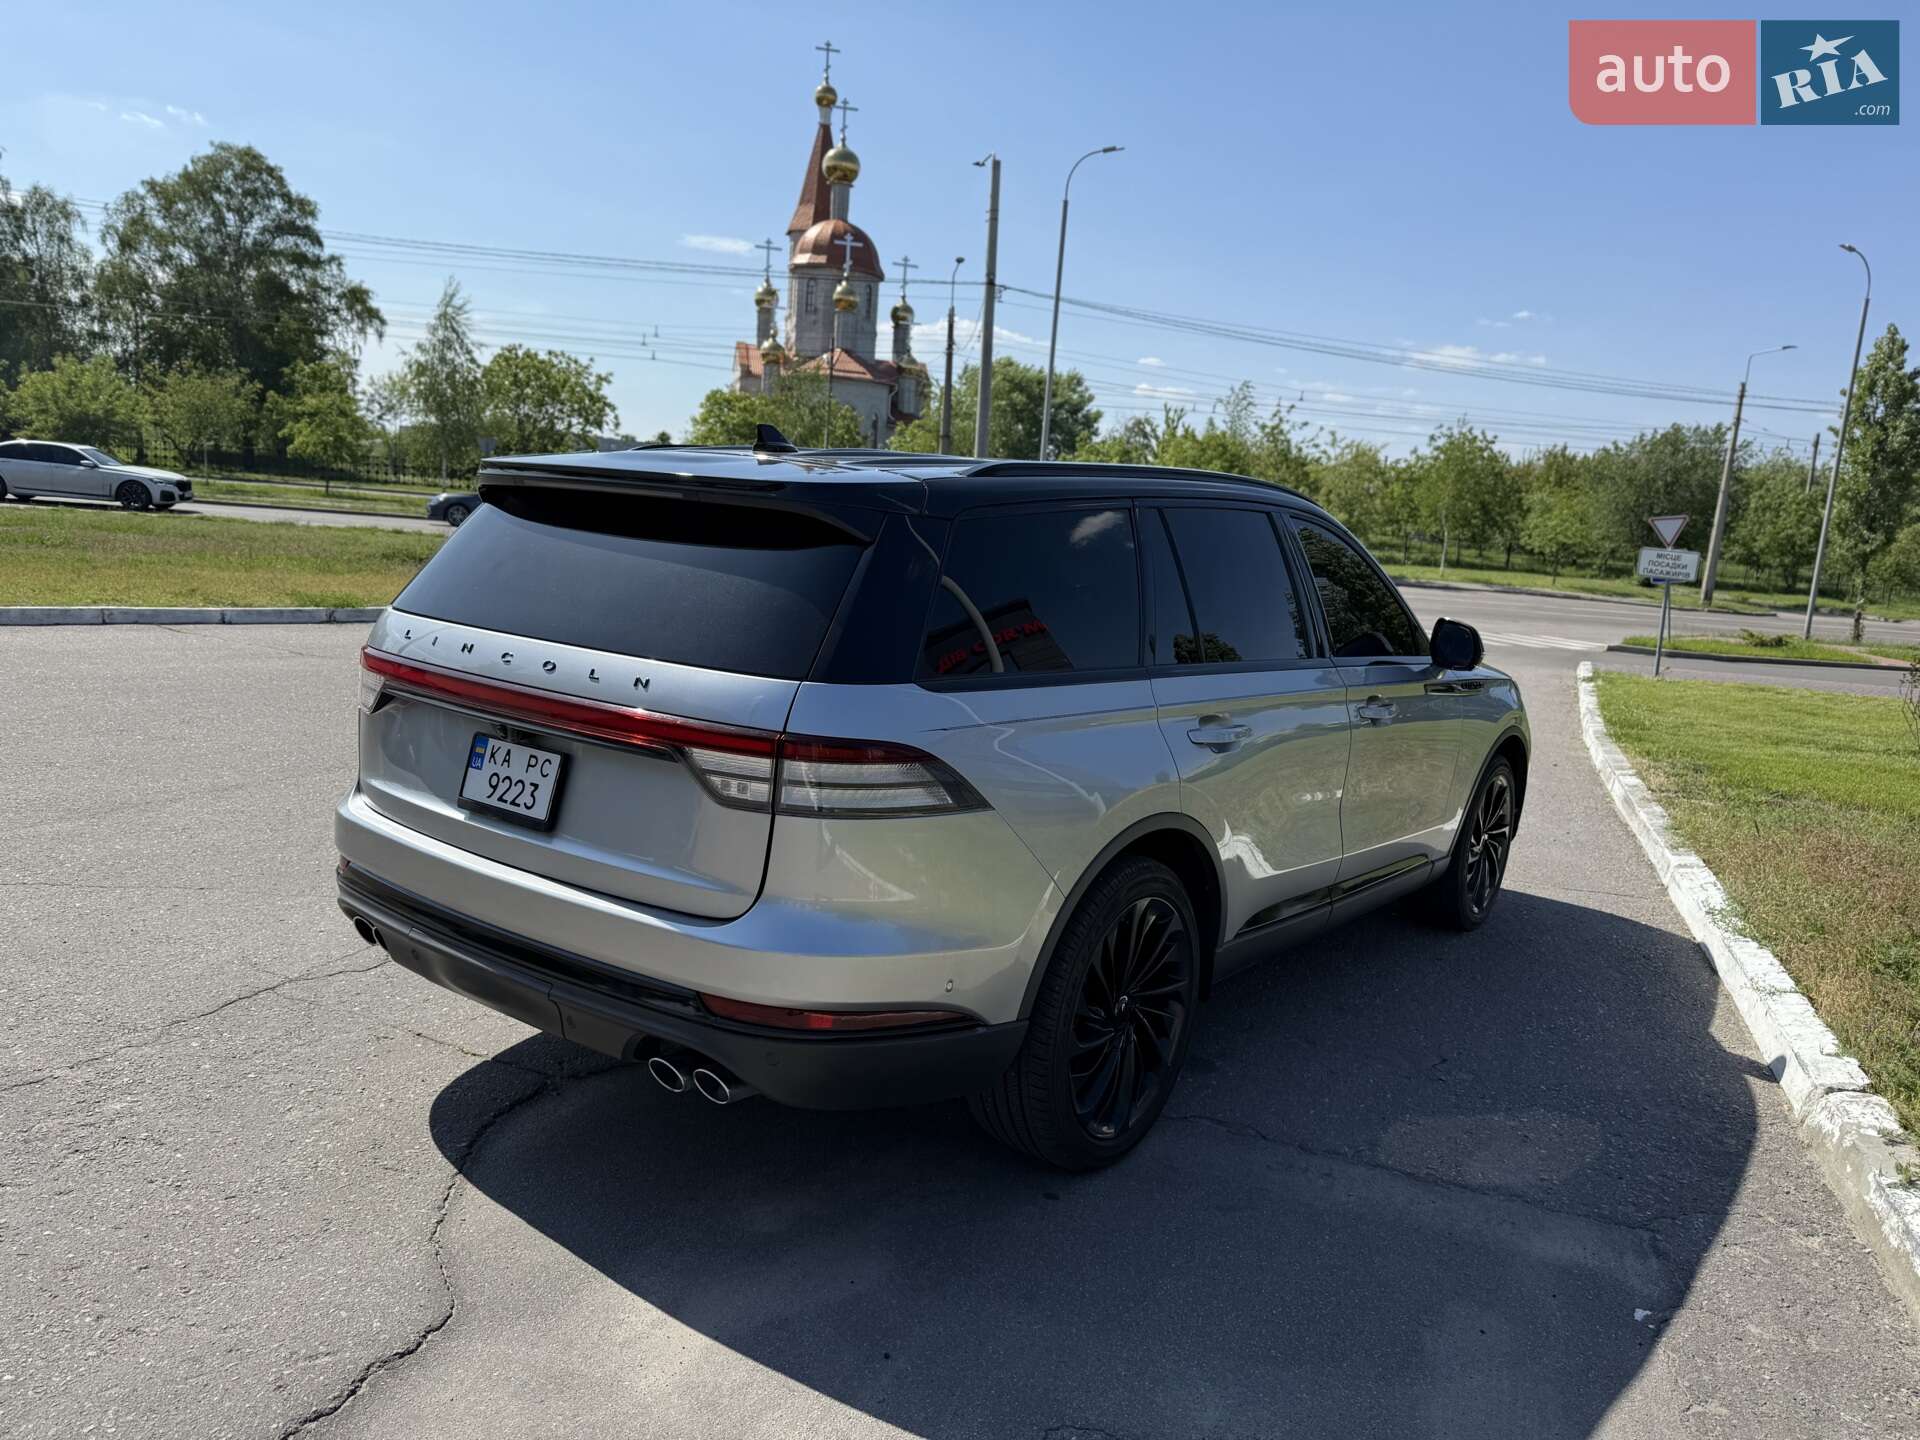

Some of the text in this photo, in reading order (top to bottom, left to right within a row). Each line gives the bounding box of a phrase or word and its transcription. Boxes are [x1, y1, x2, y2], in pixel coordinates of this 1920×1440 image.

[1648, 560, 1688, 570] ПОСАДКИ
[1656, 552, 1683, 561] МІСЦЕ
[405, 629, 651, 692] LINCOLN
[471, 757, 481, 768] UA
[488, 744, 552, 778] KA PC
[486, 772, 539, 810] 9223
